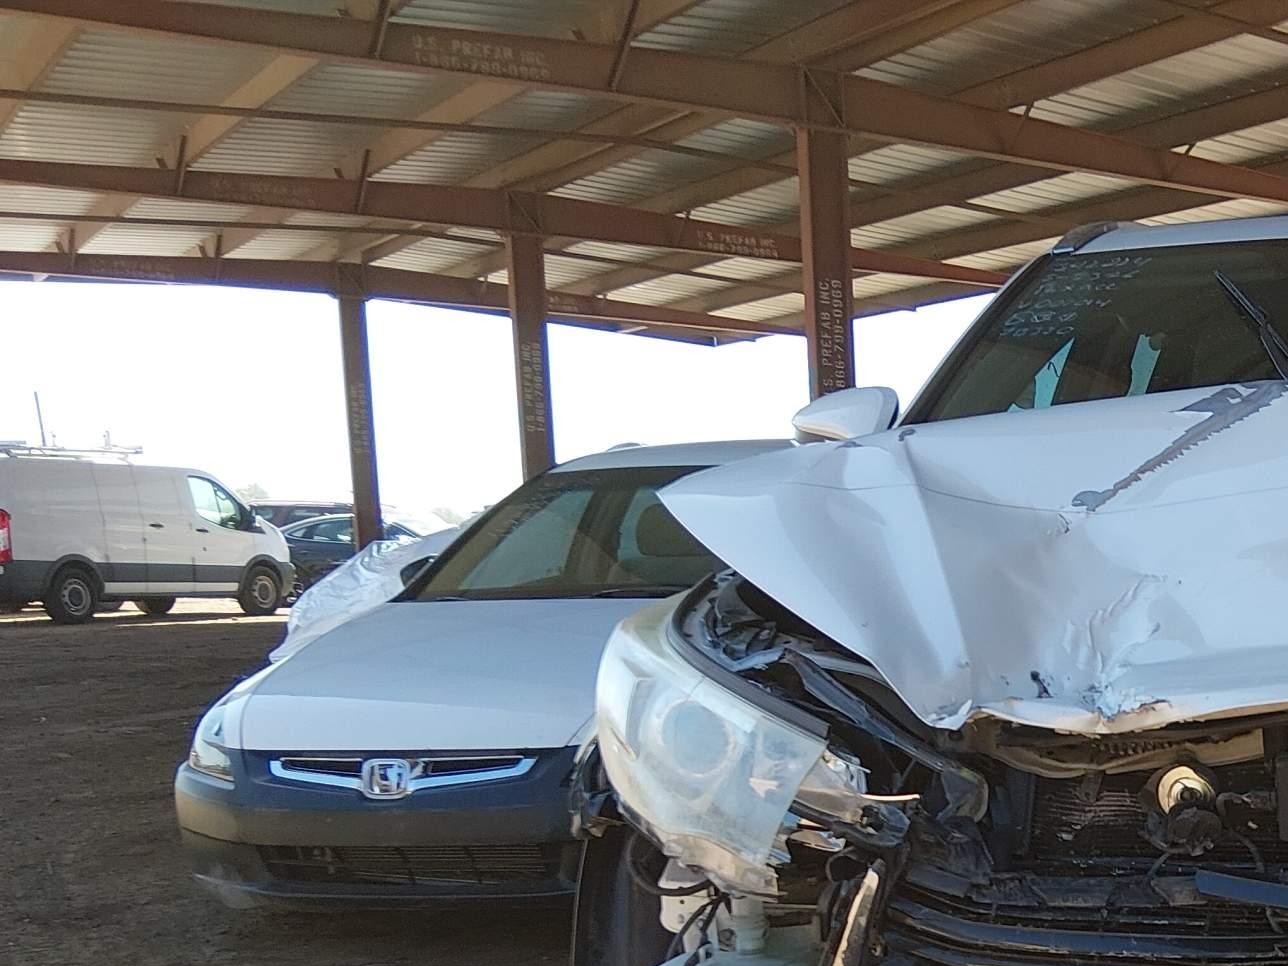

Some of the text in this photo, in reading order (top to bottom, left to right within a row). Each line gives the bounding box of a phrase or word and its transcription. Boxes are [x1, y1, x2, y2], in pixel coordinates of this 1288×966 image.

[819, 277, 832, 305] INC.
[821, 311, 833, 367] PREFAB
[831, 279, 846, 388] 866-799-0969
